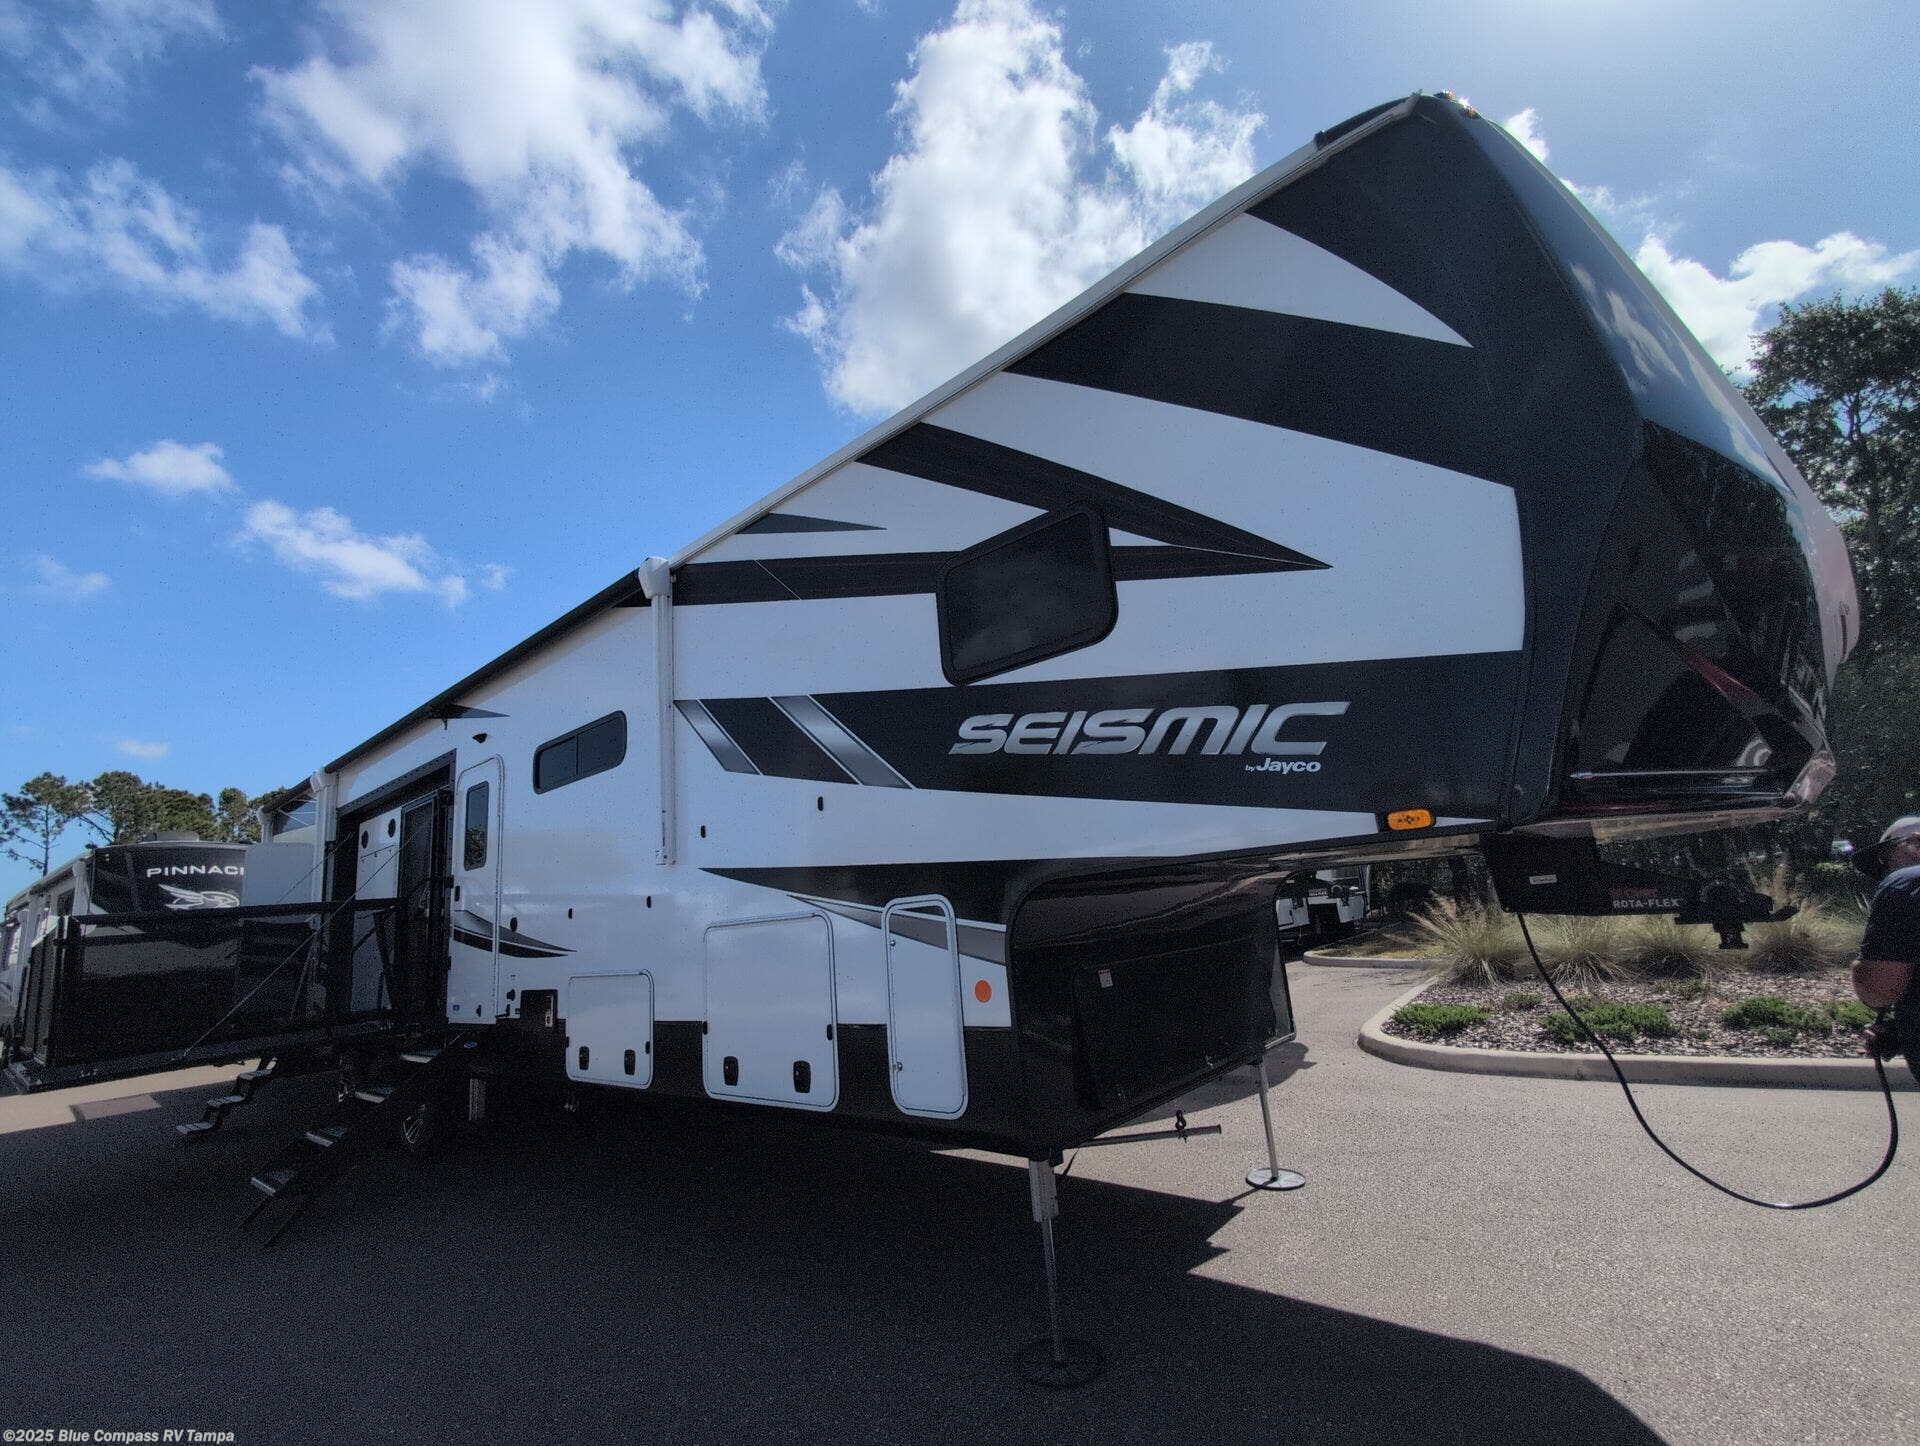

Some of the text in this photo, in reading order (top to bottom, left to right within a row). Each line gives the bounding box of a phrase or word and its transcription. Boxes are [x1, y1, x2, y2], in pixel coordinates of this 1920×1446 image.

[948, 701, 1351, 755] SEISMIC
[1256, 757, 1321, 774] Jayco
[1612, 898, 1680, 908] ROTA-FLEX
